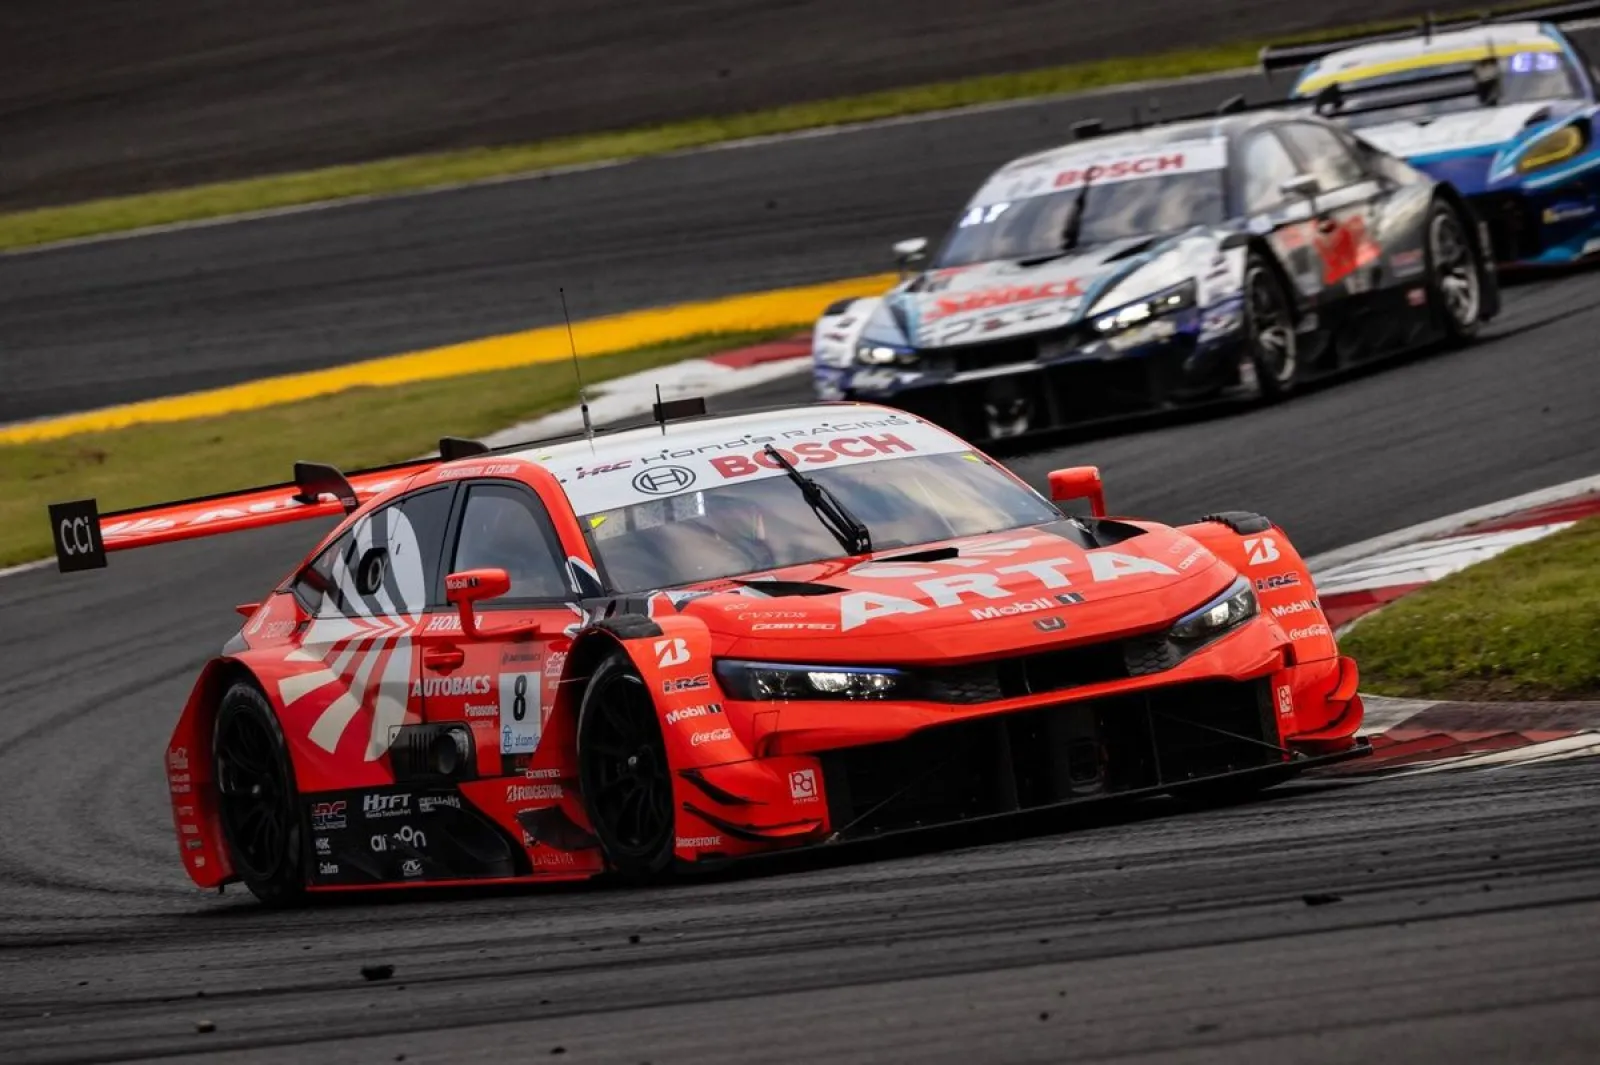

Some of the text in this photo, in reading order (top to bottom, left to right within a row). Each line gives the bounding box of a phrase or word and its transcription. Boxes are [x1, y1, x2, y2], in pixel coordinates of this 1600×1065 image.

[1053, 153, 1186, 189] BOSCH
[577, 460, 633, 480] HRC
[781, 417, 911, 441] RACING
[708, 432, 918, 480] BOSCH
[445, 579, 469, 590] Mobil
[840, 551, 1182, 633] ARTA
[968, 596, 1055, 621] Mobil
[1271, 599, 1311, 618] Mobil
[427, 615, 483, 631] HONA
[410, 675, 491, 698] AUTOBACS
[663, 674, 711, 694] HRC
[512, 674, 528, 722] 8
[464, 701, 499, 718] Panasonic
[665, 704, 707, 725] Mobil
[691, 728, 732, 746] Coca-Cola
[506, 784, 564, 803] BRIDGESTONE
[675, 835, 721, 848] BRIDGESTONE
